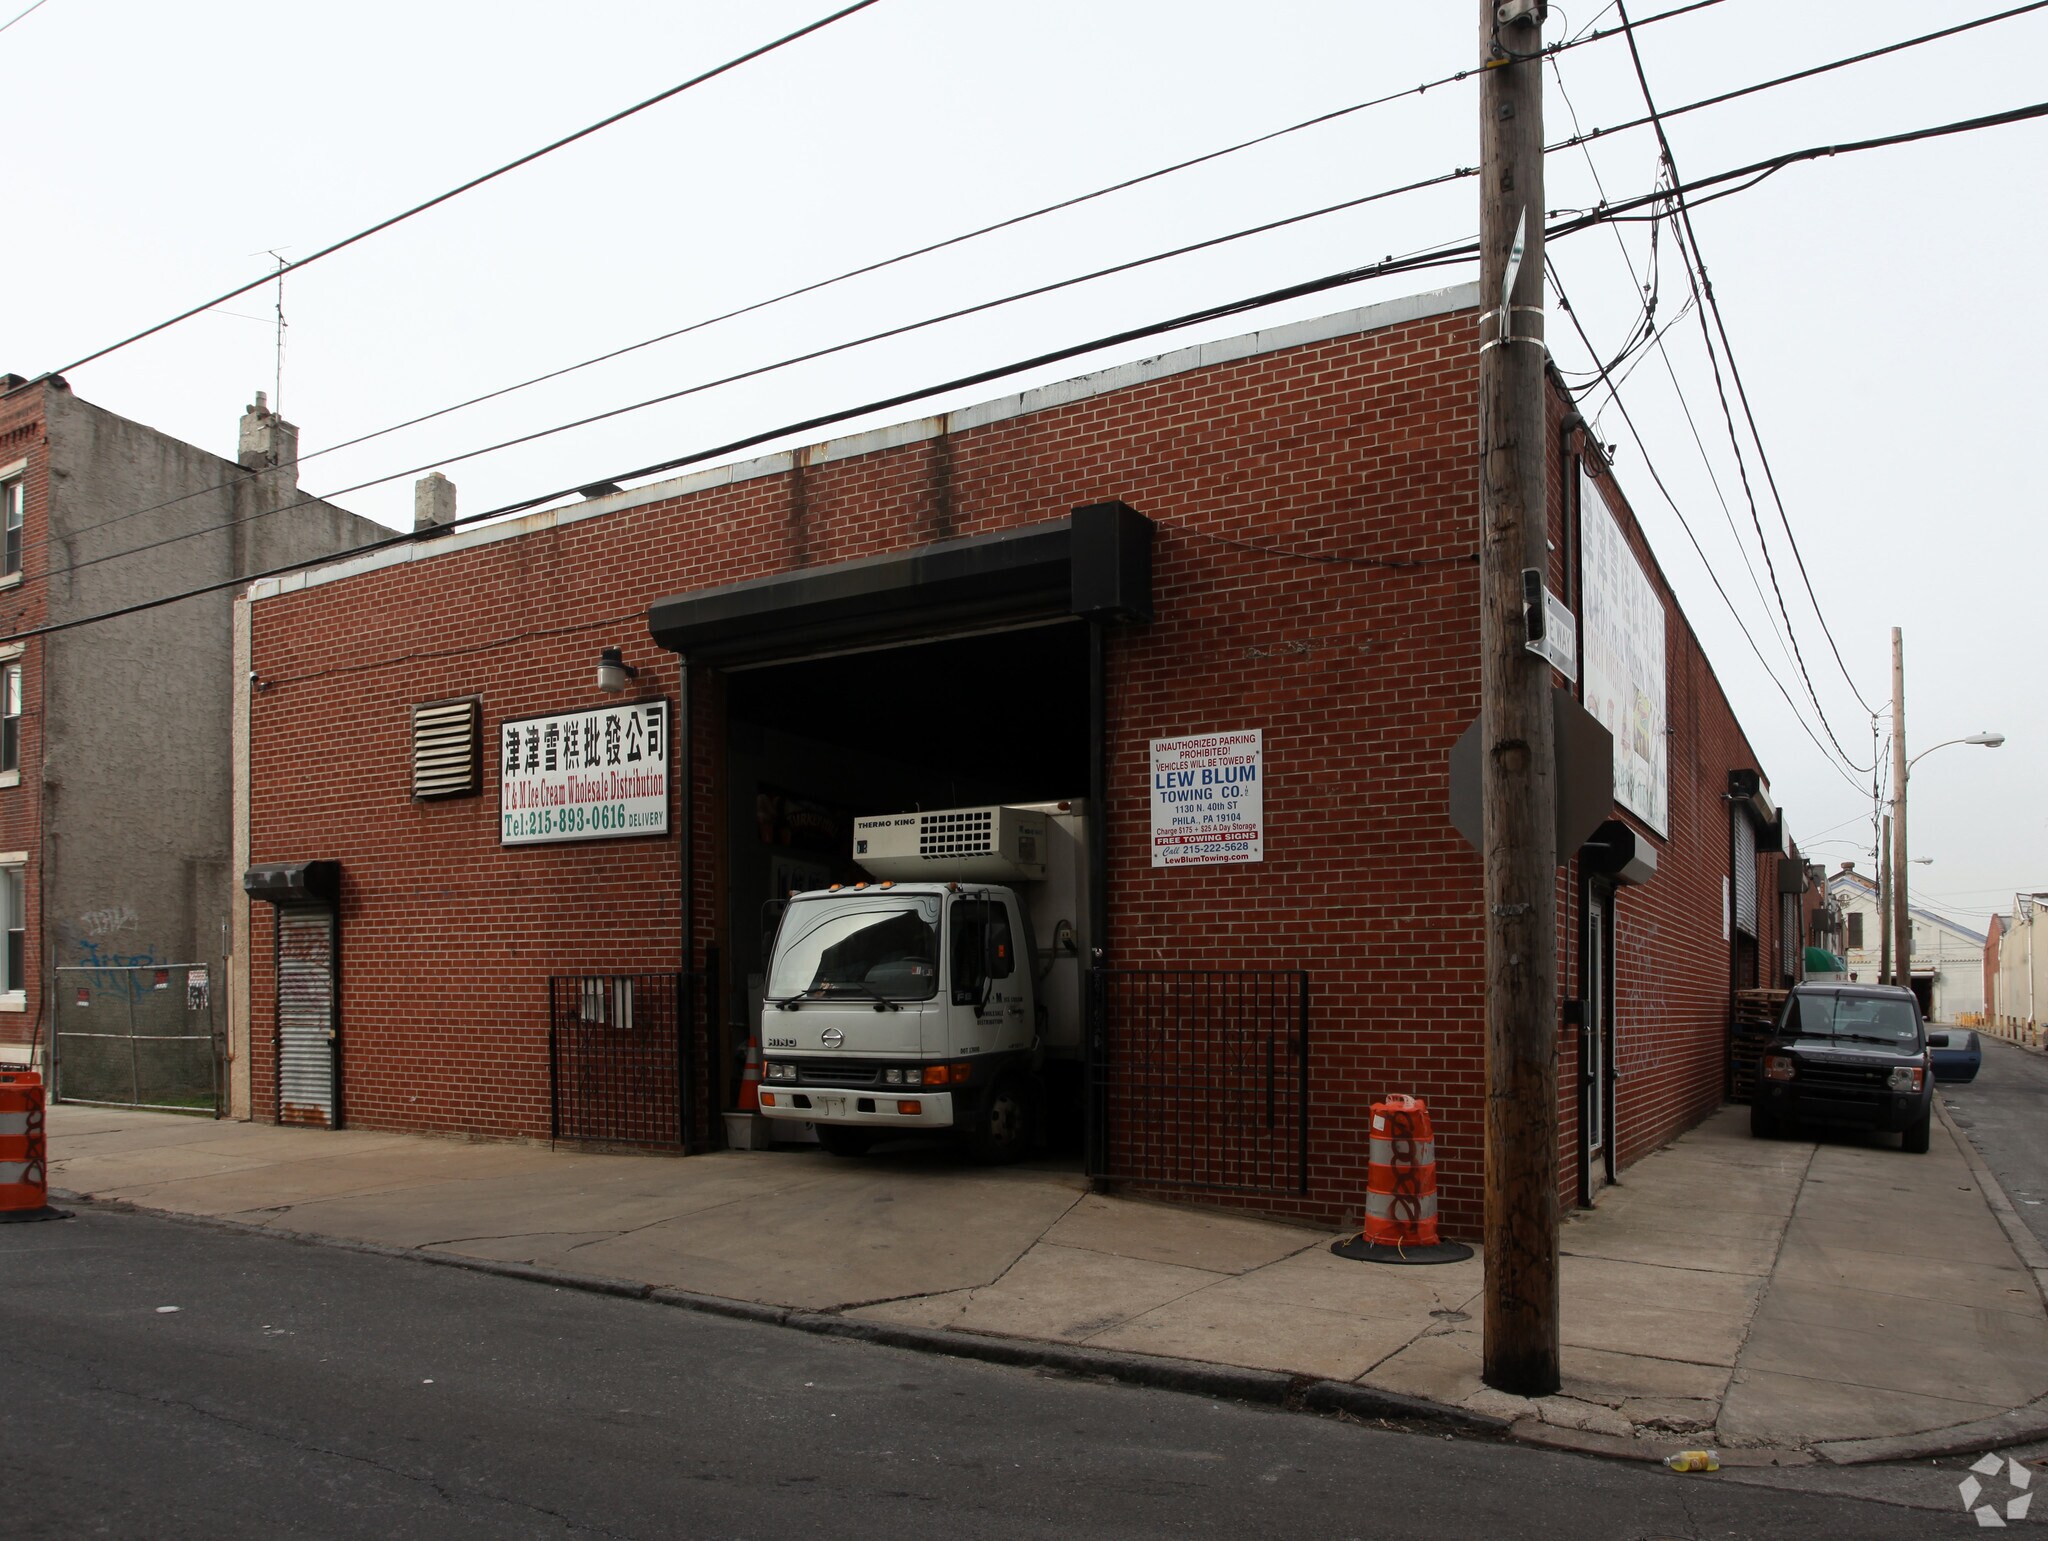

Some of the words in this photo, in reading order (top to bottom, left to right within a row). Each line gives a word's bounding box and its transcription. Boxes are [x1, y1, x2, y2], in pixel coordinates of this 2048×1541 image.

[1556, 621, 1571, 656] WAY
[505, 706, 664, 778] 津津雪糕批發公司
[1156, 737, 1218, 752] UNAUTHORIZED
[1219, 734, 1256, 747] PARKING
[1180, 746, 1231, 759] PROHIBITED!
[1156, 760, 1189, 772] VEHICLES
[1190, 758, 1207, 770] WILL
[1207, 757, 1217, 768] BE
[1219, 756, 1244, 767] TOWED
[1246, 755, 1255, 764] BY
[1156, 770, 1195, 789] LEW
[1202, 764, 1256, 785] BLUM
[505, 783, 511, 810] T
[511, 788, 517, 810] &
[519, 781, 527, 809] M
[528, 780, 539, 808] Ice
[541, 778, 566, 808] Cream
[568, 772, 609, 804] Wholesale
[610, 765, 664, 801] Distribution
[1160, 787, 1213, 803] TOWING
[1221, 785, 1244, 799] CO.
[1175, 804, 1194, 814] 1130
[1196, 803, 1205, 812] N.
[1207, 802, 1225, 811] 40th
[1227, 801, 1238, 810] ST
[505, 803, 626, 837] Tel:215-893-0616
[629, 811, 664, 828] DELIVERY
[858, 820, 892, 829] THERMO
[894, 818, 916, 826] KING
[1203, 814, 1214, 823] PA
[1216, 812, 1241, 822] 19104
[1156, 827, 1178, 838] Charge
[1179, 825, 1193, 834] $175
[1200, 824, 1211, 833] $25
[1219, 823, 1231, 833] Day
[1232, 822, 1257, 833] Storage
[1157, 837, 1181, 845] FREE
[1183, 834, 1222, 843] TOWING
[1224, 832, 1256, 840] SIGNS
[1162, 846, 1181, 857] Call
[1183, 842, 1249, 854] 215-222-5628
[1165, 853, 1249, 865] LewBlumTowing.com
[768, 1038, 797, 1048] HINO
